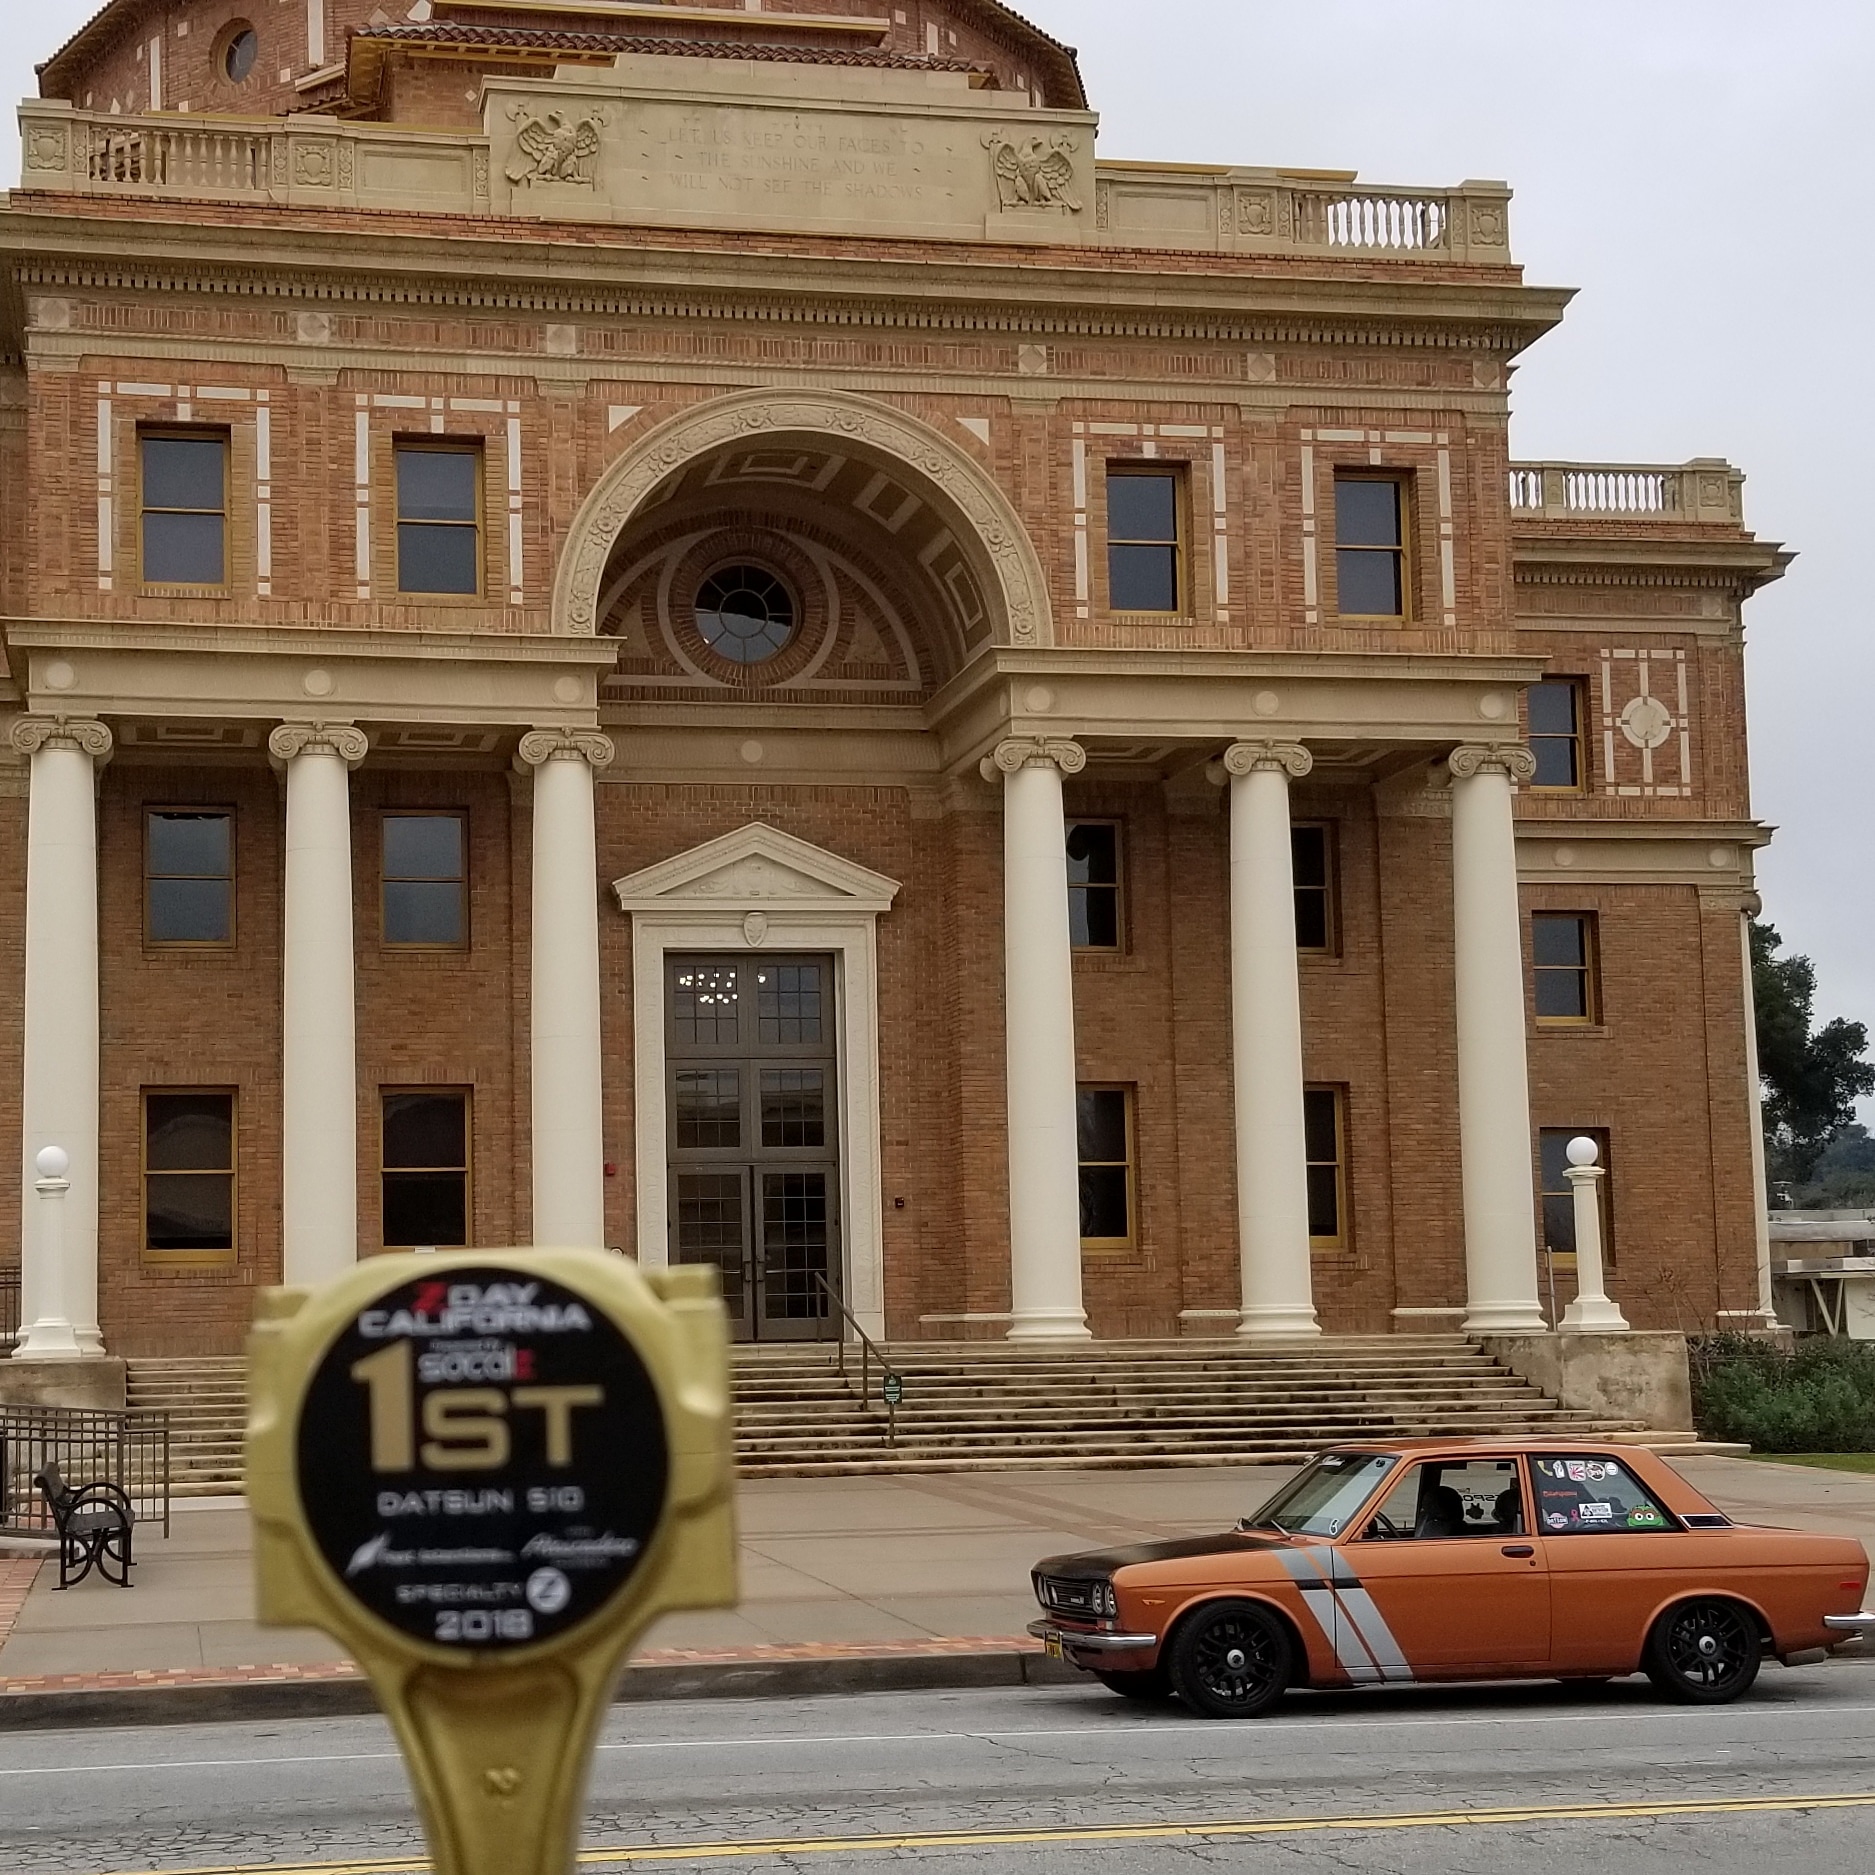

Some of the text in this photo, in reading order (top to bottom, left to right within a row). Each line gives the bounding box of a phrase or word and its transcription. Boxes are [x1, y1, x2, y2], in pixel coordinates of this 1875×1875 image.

[668, 127, 700, 144] LET
[713, 129, 733, 145] US
[793, 135, 828, 152] OUR
[839, 137, 890, 154] FACES
[899, 140, 924, 155] TO
[697, 151, 897, 176] THE SUNSHINE AND WE
[669, 173, 923, 200] WILL NOT SEE THE SHADOWS
[448, 1283, 540, 1308] DAY
[358, 1303, 592, 1338] CALIFORNIA
[351, 1338, 605, 1474] 1ST
[377, 1486, 585, 1516] DATSUN 510
[435, 1609, 534, 1640] 2018
